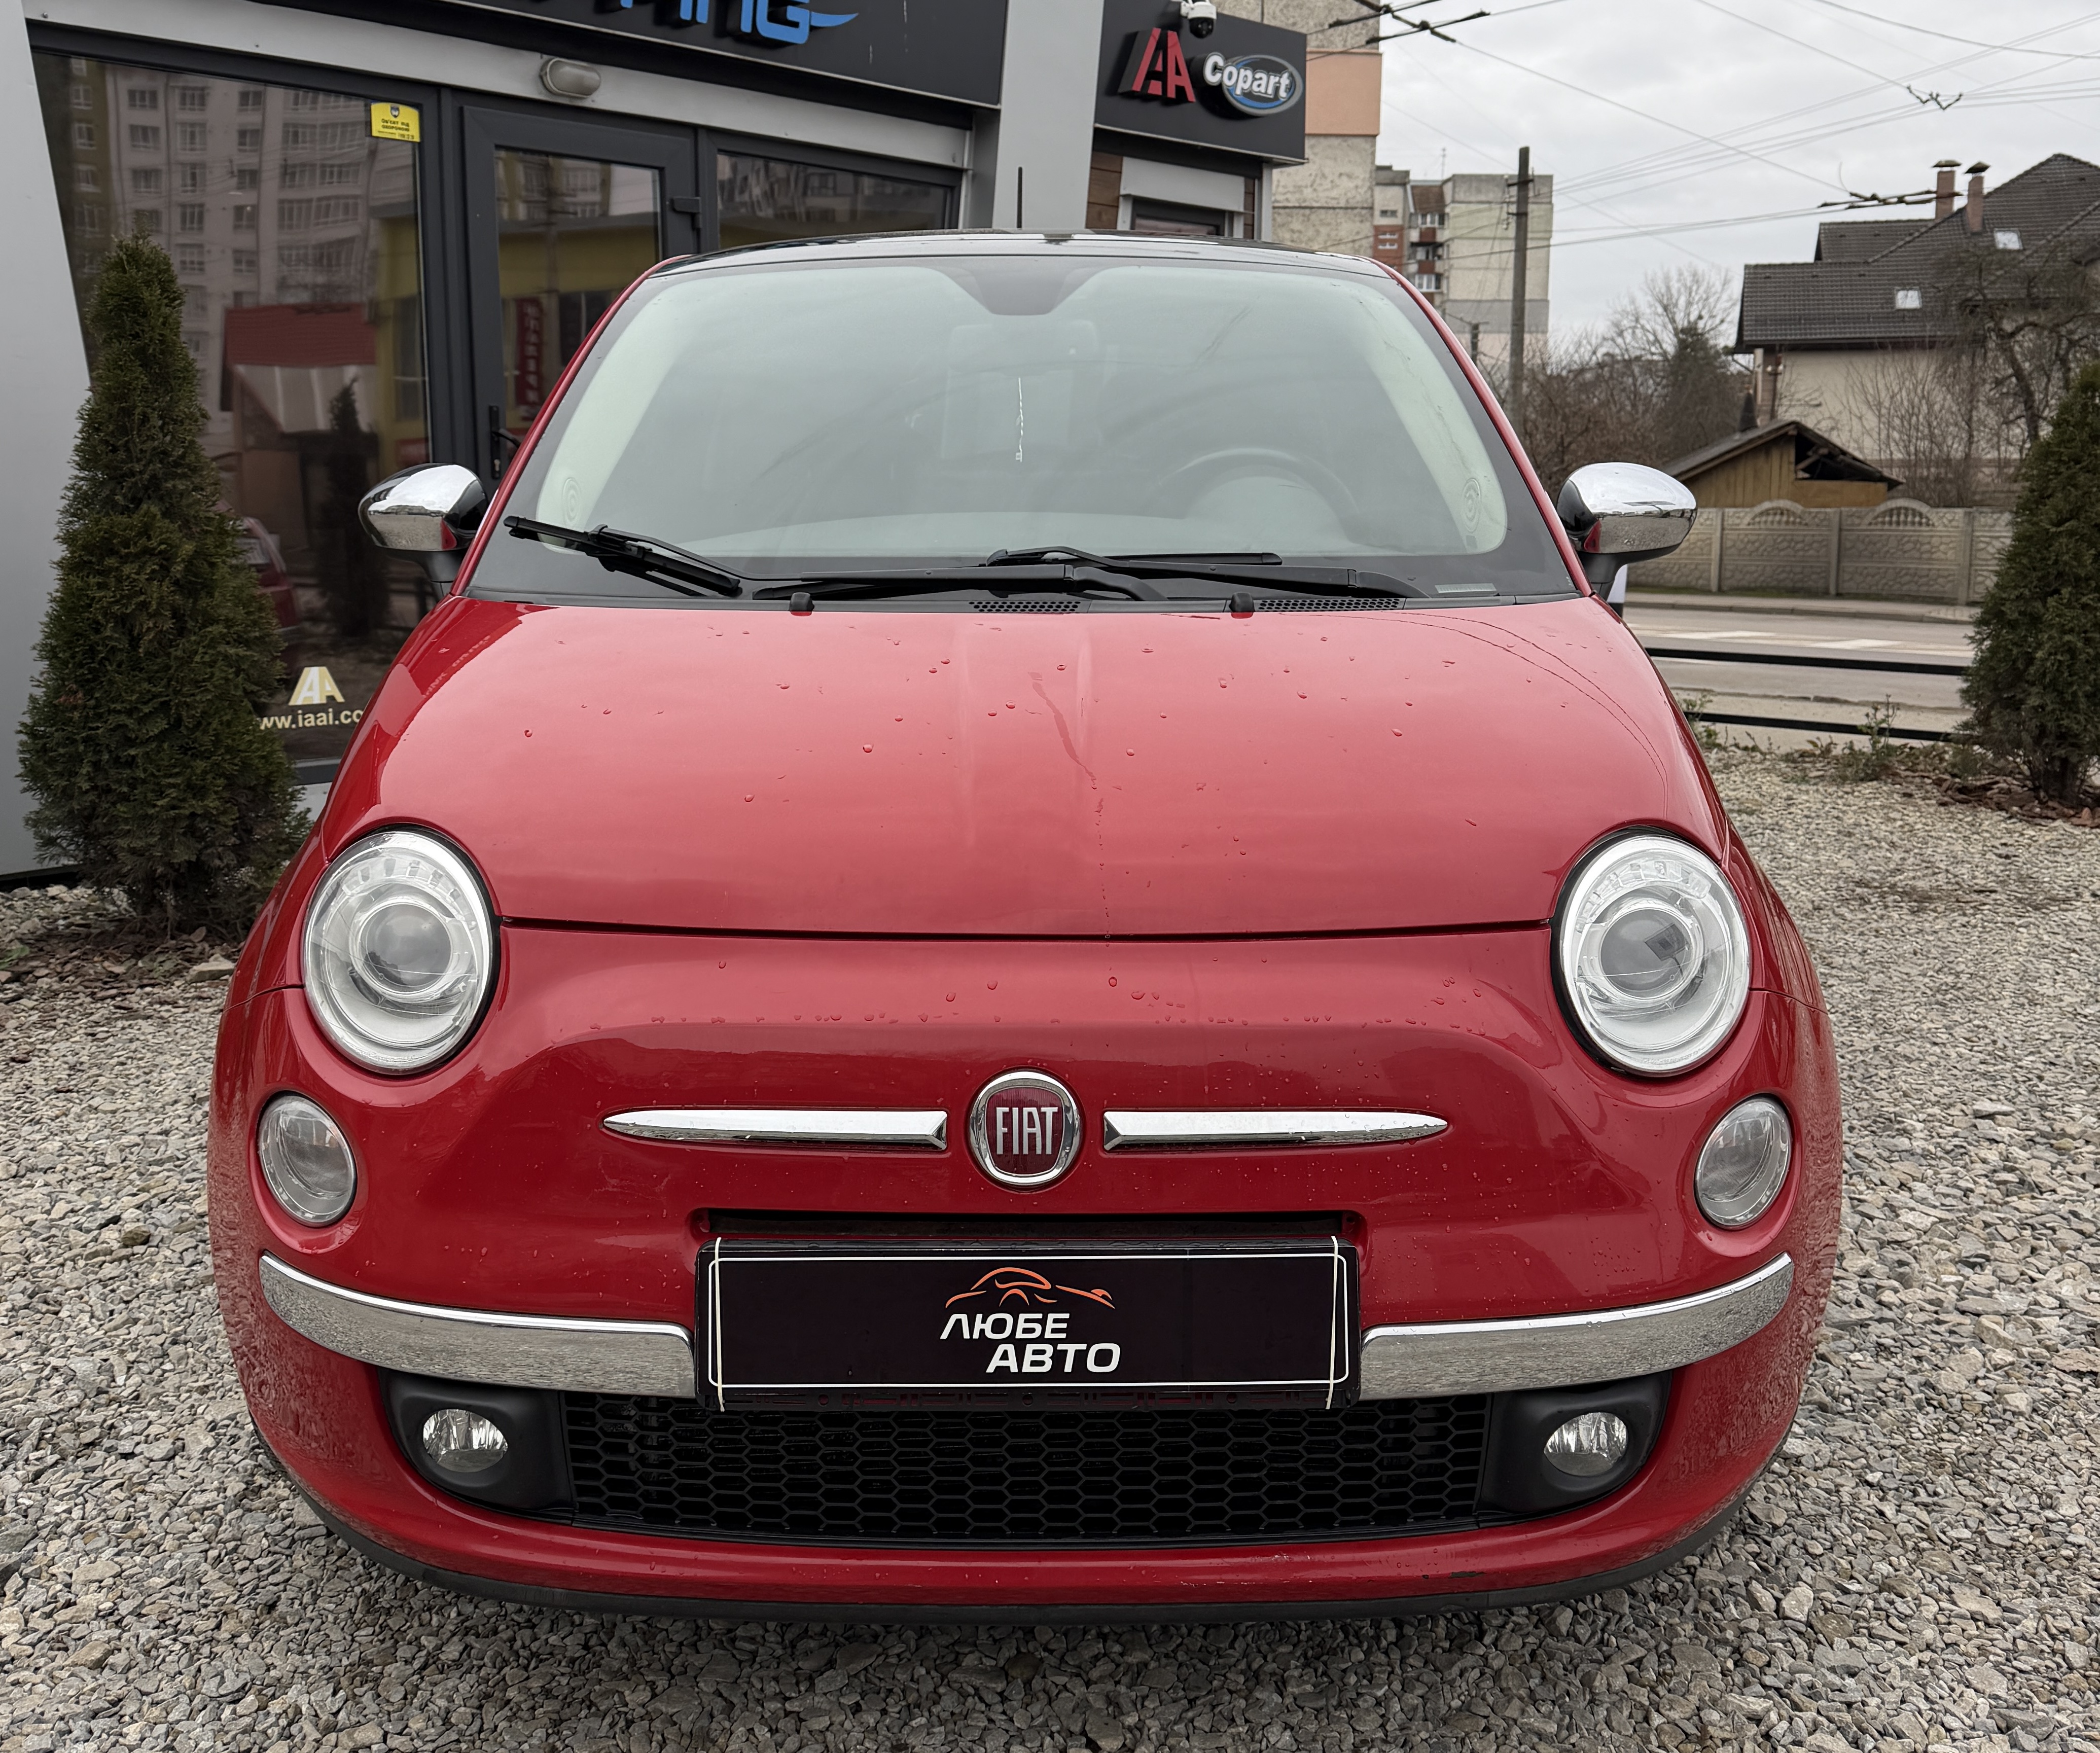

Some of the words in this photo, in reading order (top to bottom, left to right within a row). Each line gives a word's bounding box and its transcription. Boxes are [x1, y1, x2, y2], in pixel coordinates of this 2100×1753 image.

[1203, 53, 1292, 99] Copart
[257, 708, 365, 730] ww.iaai.co
[996, 1107, 1058, 1155] FIAT
[940, 1313, 1070, 1339] ЛЮБЕ
[985, 1343, 1121, 1373] АВТО
